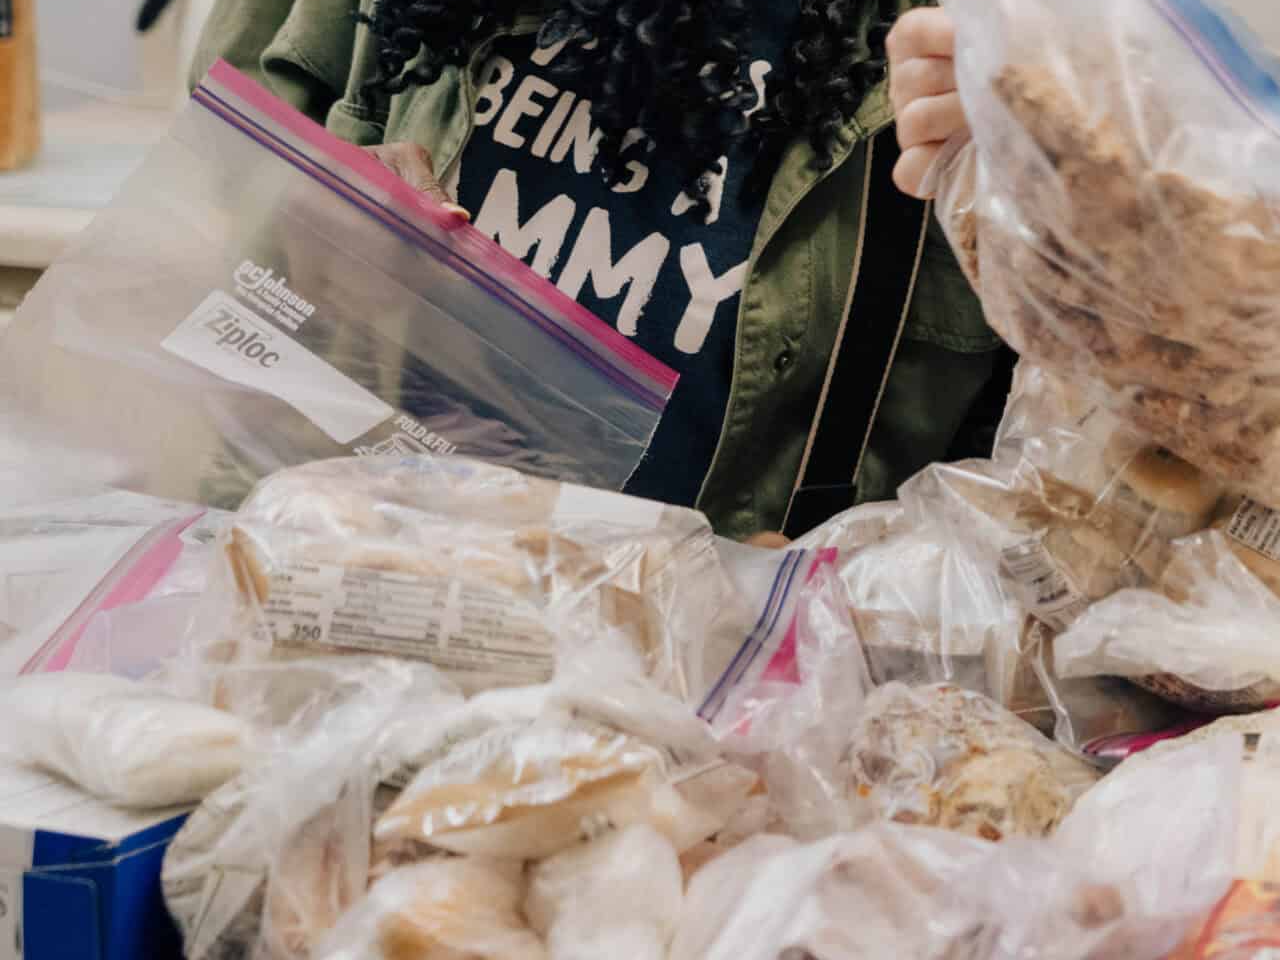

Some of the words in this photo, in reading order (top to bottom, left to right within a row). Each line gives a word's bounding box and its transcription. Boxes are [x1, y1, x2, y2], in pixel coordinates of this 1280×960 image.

[470, 168, 750, 354] MMY
[203, 308, 280, 369] Ziploc
[393, 415, 428, 439] FOLD
